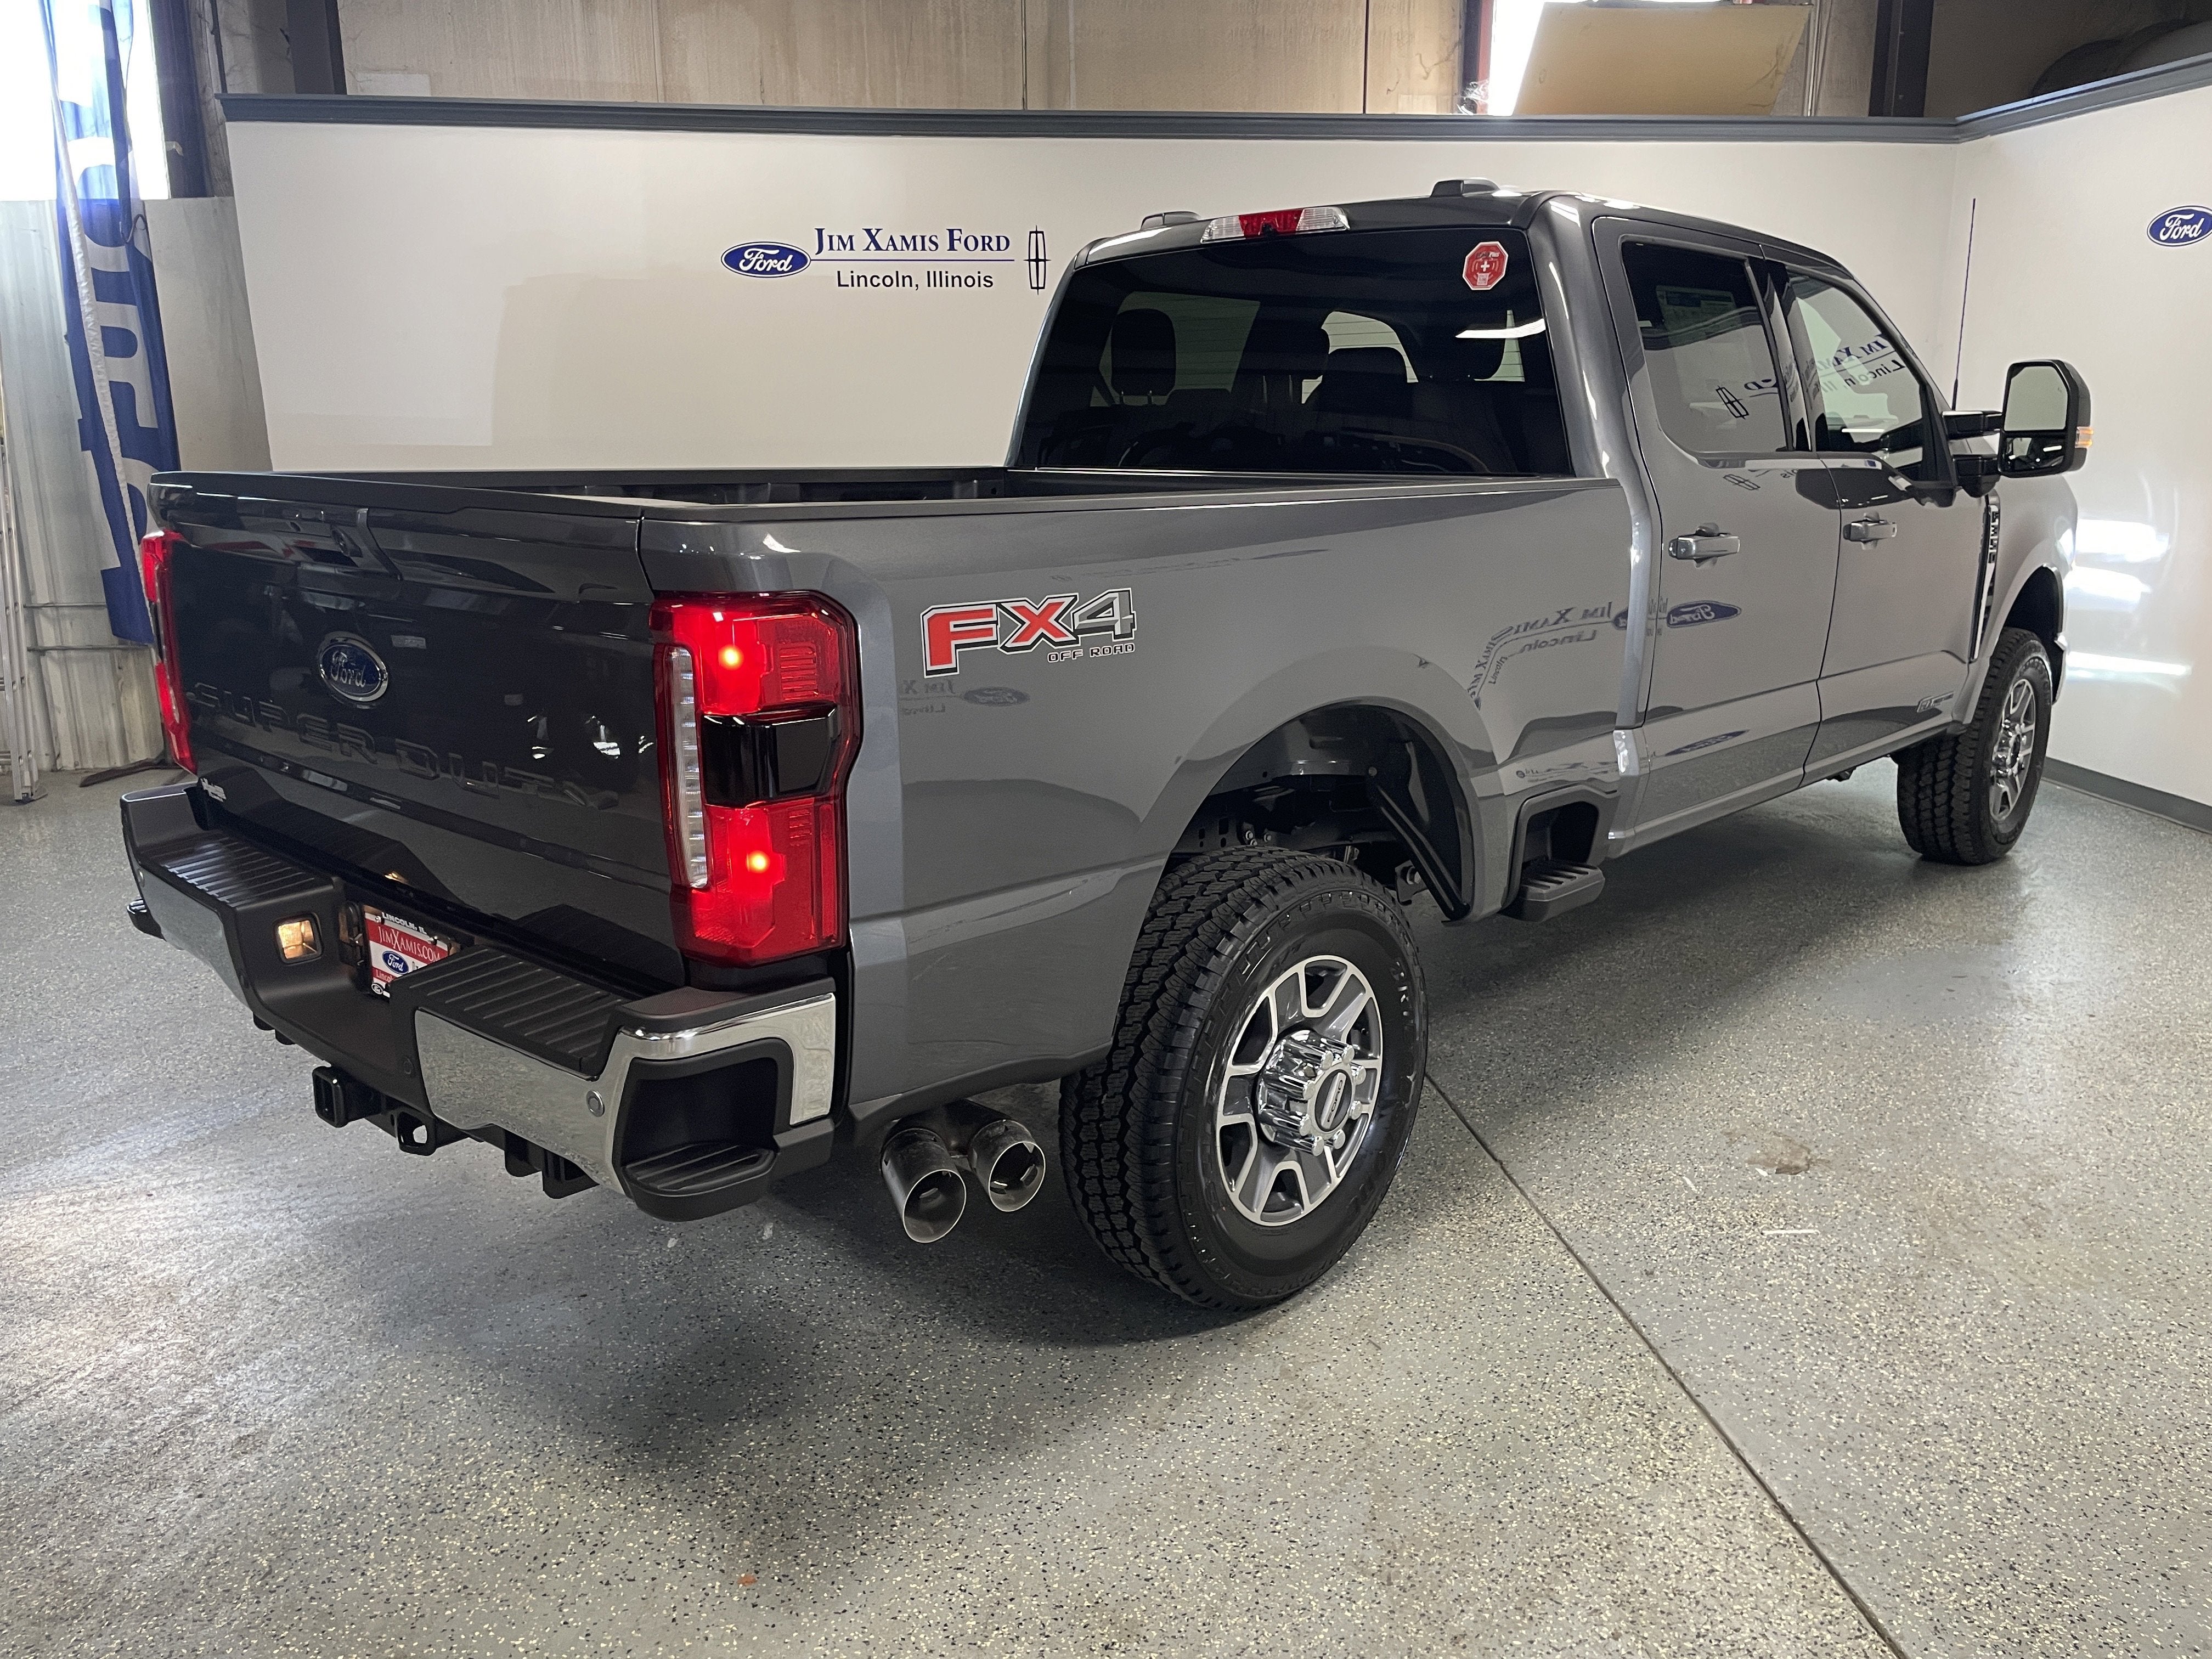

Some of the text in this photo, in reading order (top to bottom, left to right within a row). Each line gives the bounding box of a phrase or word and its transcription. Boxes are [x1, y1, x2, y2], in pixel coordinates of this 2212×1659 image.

[2159, 213, 2205, 240] Ford
[738, 248, 793, 272] Ford
[837, 270, 994, 291] Lincoln, Illinois
[919, 587, 1137, 679] FX4
[1047, 643, 1136, 663] OFF ROAD
[189, 682, 377, 764] SUPER
[387, 953, 404, 972] Ford
[1327, 1080, 1343, 1122] FORD
